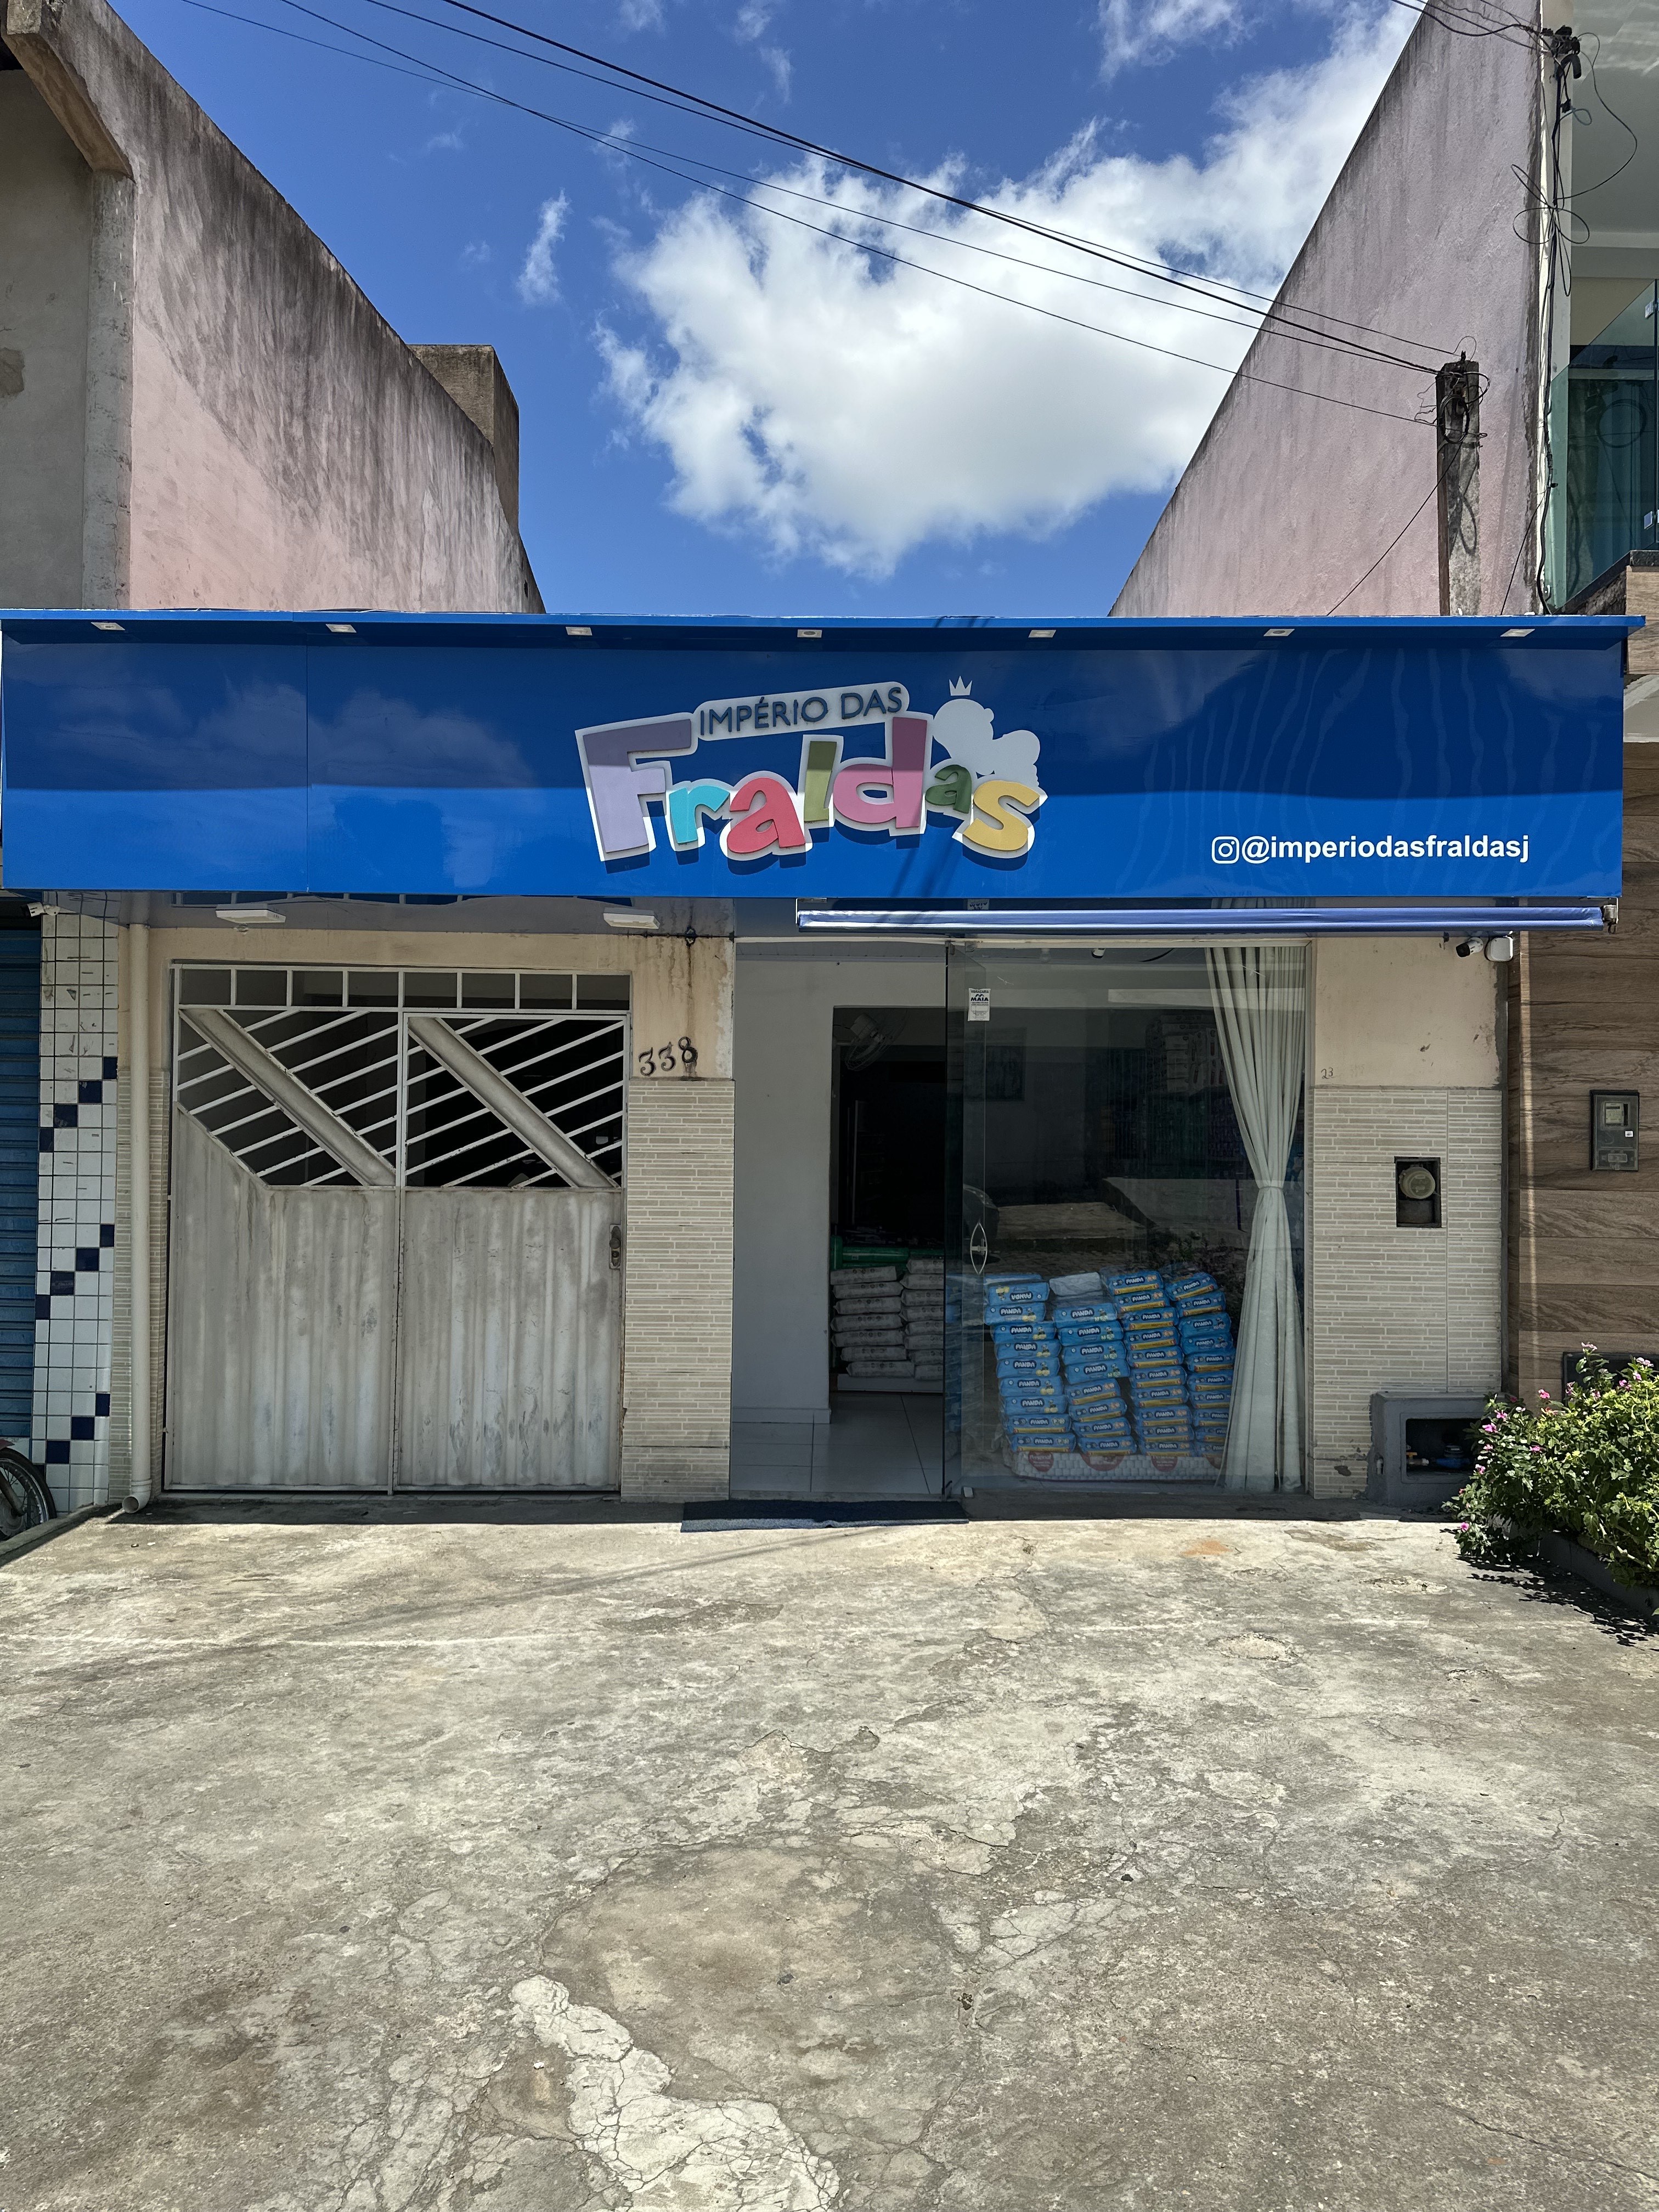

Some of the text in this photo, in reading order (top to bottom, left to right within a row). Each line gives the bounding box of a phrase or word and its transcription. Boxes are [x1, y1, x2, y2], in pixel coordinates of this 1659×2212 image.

[700, 687, 902, 736] IMPÉRIO DAS
[583, 716, 1041, 854] Fraldas
[1242, 835, 1529, 864] @imperiodasfraldasj
[638, 1036, 698, 1076] 338
[1321, 1067, 1333, 1079] 23
